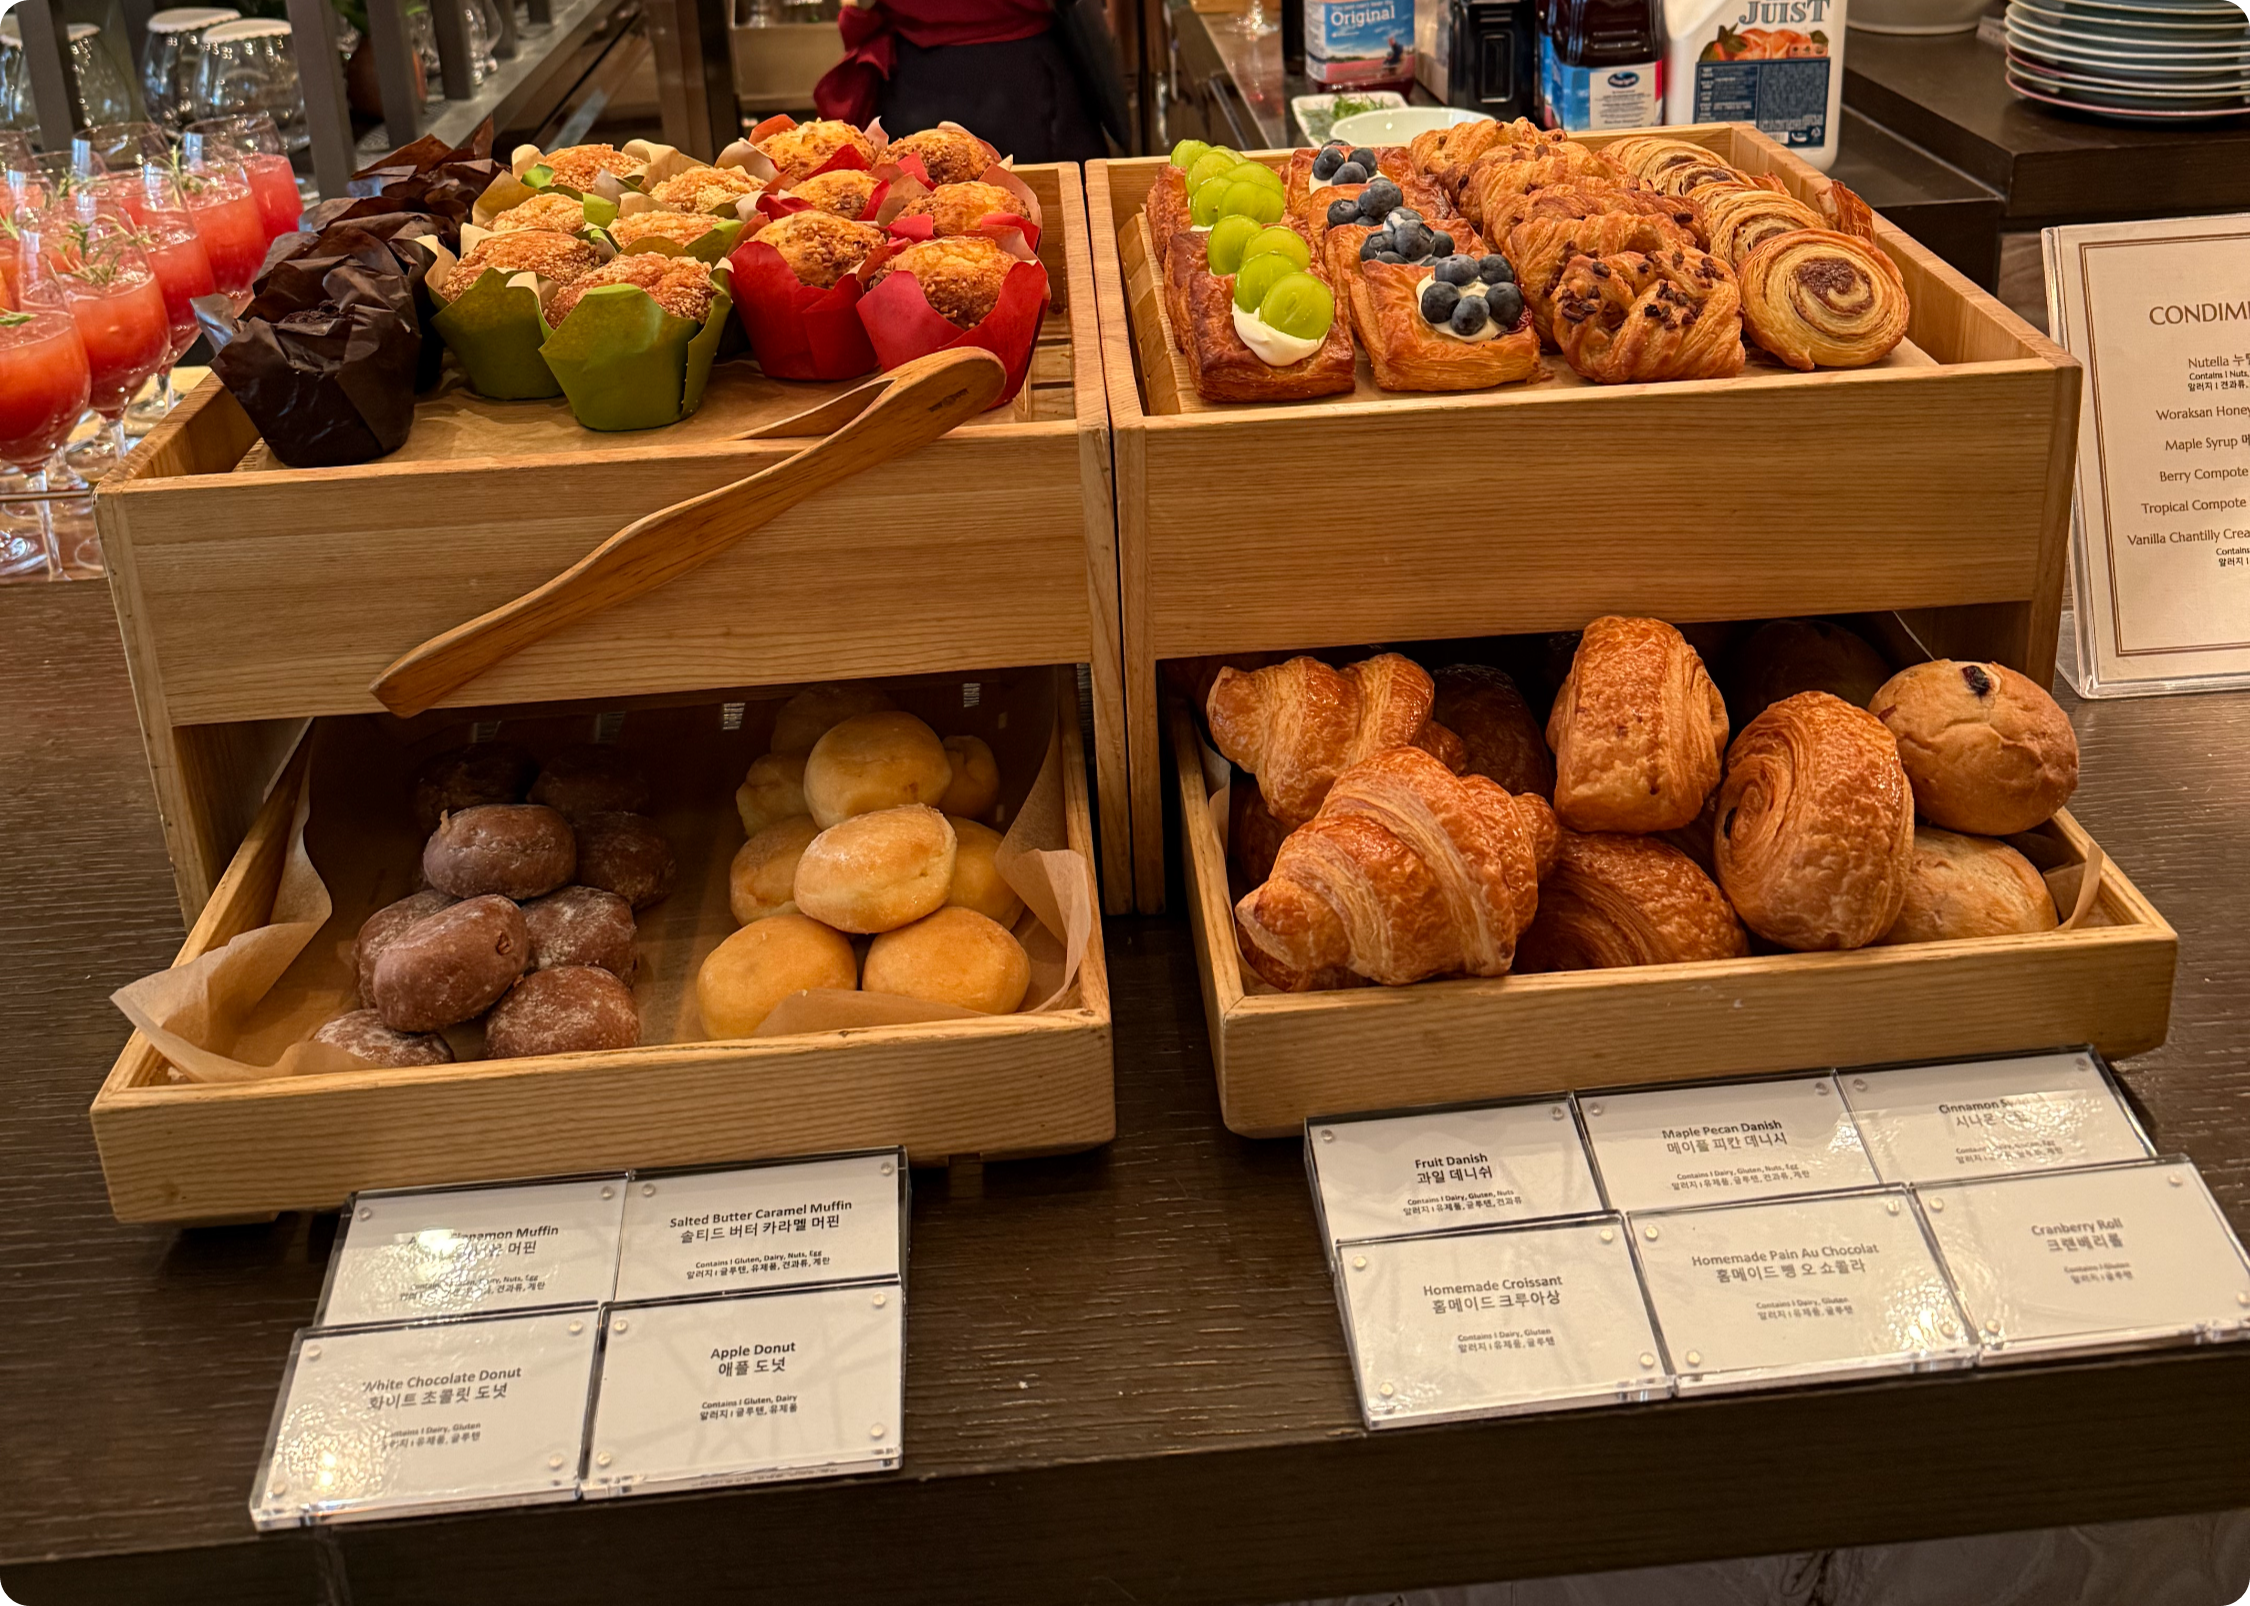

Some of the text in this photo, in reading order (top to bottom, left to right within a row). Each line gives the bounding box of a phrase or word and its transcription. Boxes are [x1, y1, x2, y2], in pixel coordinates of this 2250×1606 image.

[1331, 5, 1395, 27] Original
[1739, 0, 1830, 25] JUIST
[2149, 301, 2250, 326] CONDIM
[2188, 356, 2229, 368] Nutella
[2189, 371, 2223, 380] Contains
[2188, 381, 2212, 392] 알러지
[2156, 408, 2212, 420] Woraksan
[2165, 438, 2202, 452] Maple
[2206, 437, 2238, 451] Syrup
[2160, 467, 2249, 484] Berry Compote
[2140, 498, 2247, 516] Tropical Compote
[2127, 533, 2166, 546] Vanilla
[2169, 529, 2220, 543] Chantilly
[1938, 1100, 1999, 1114] Cinnamon
[1662, 1120, 1782, 1140] Maple Pecan Danish
[1666, 1132, 1788, 1155] 메이플 피칸 데니시
[1415, 1152, 1488, 1169] Fruit Danish
[1417, 1165, 1493, 1184] 과일 데니쉬
[1676, 1172, 1709, 1181] Contains
[1407, 1196, 1439, 1206] Contains
[1445, 1194, 1468, 1202] Dairy,
[1468, 1191, 1496, 1200] Gluten,
[670, 1200, 852, 1228] Salted Butter Caramel Muffin
[516, 1225, 559, 1238] Muffin
[681, 1214, 839, 1244] 솔티드 버터 카라멜 머핀
[2031, 1217, 2124, 1236] Cranberry Roll
[508, 1240, 537, 1255] 머핀
[1692, 1243, 1880, 1266] Homemade Pain Au Chocolat
[695, 1260, 728, 1269] Contains
[734, 1256, 762, 1265] Gluten,
[764, 1253, 786, 1262] Dairy,
[788, 1250, 807, 1259] Nuts,
[686, 1268, 713, 1280] 알러지
[1716, 1265, 1780, 1284] 홈메이드
[1801, 1262, 1816, 1276] 오
[1423, 1275, 1563, 1296] Homemade Croissant
[1432, 1289, 1560, 1314] 홈메이드 크루아상
[1457, 1333, 1492, 1342] Contains
[1524, 1328, 1551, 1336] Gluten
[711, 1342, 796, 1360] Apple Donut
[719, 1356, 786, 1377] 애플 도넛
[407, 1371, 476, 1388] Chocolate
[479, 1367, 522, 1382] Donut
[474, 1383, 508, 1400] 도넛
[702, 1401, 737, 1410] Contains
[743, 1397, 774, 1406] Gluten,
[776, 1394, 797, 1403] Dairy
